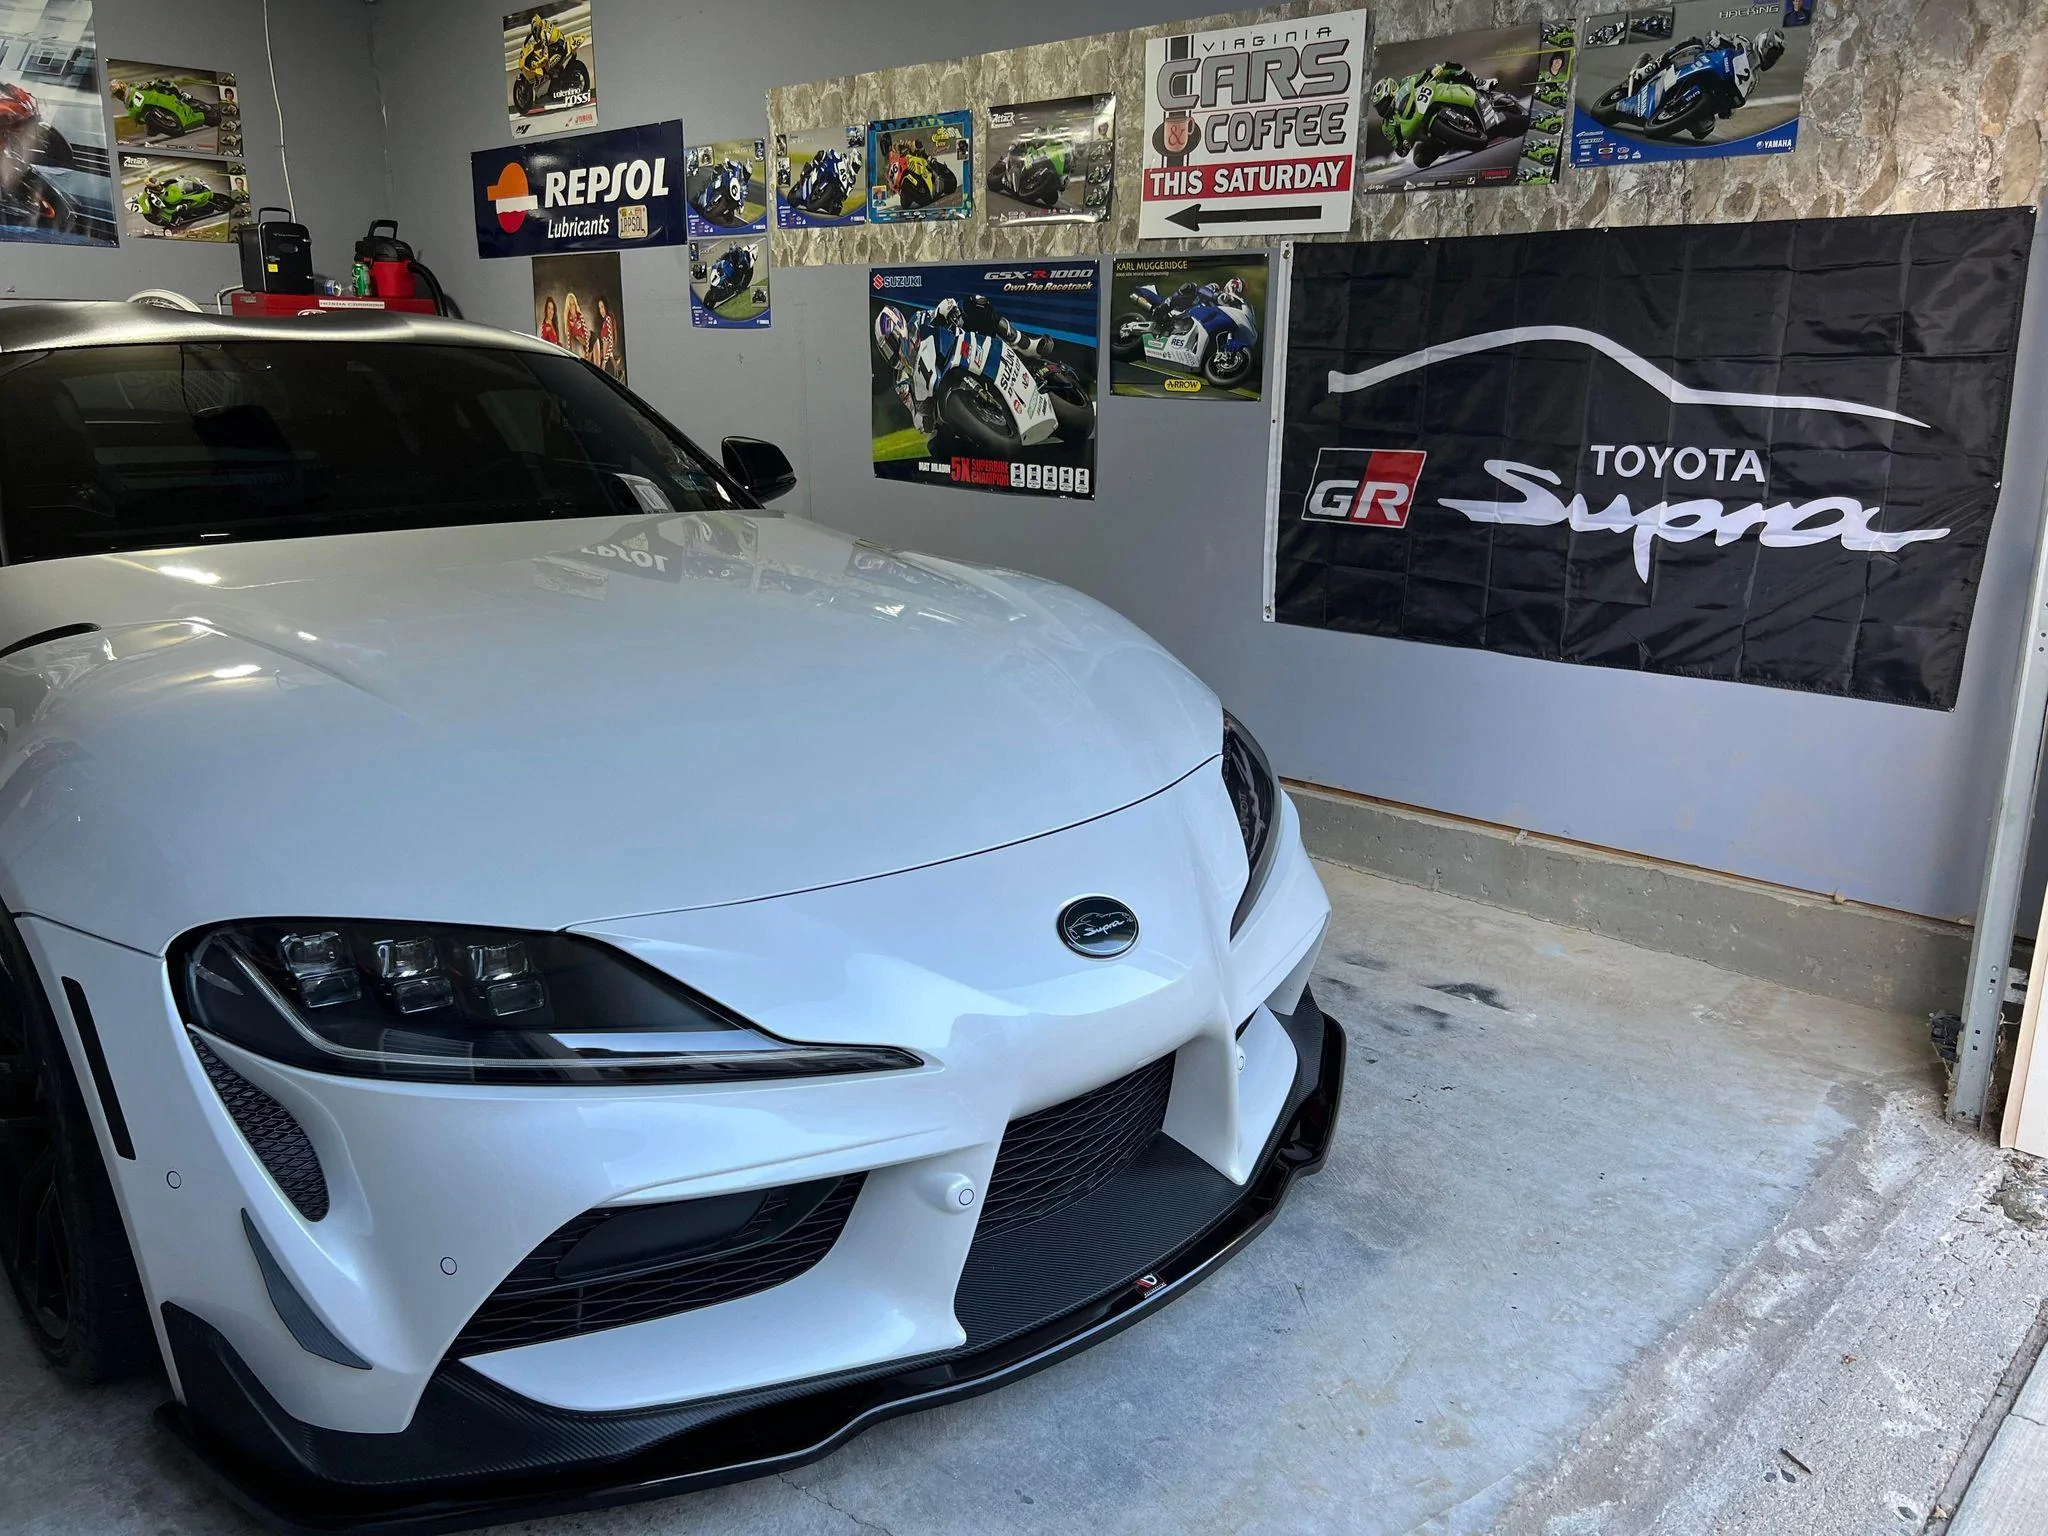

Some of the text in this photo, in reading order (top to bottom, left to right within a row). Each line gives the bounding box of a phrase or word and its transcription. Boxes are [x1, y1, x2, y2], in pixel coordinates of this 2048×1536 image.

[1202, 26, 1332, 52] VIRGINIA
[1156, 38, 1351, 112] CARS
[564, 90, 591, 106] rossi
[1204, 102, 1349, 154] COFFEE
[1764, 138, 1792, 149] YAMAHA
[544, 157, 669, 209] REPSOL
[1150, 160, 1345, 196] THIS SATURDAY
[547, 213, 610, 239] Lubricants
[1116, 260, 1188, 271] KARL MUGGERIDGE
[883, 275, 923, 288] SUZUKI
[1003, 280, 1093, 292] Own The Racetrack
[1171, 337, 1185, 348] RES
[951, 456, 971, 483] 5X
[1590, 444, 1766, 484] TOYOTA
[1309, 479, 1411, 524] GR
[1437, 458, 1952, 585] Supra
[1083, 920, 1125, 936] Supra
